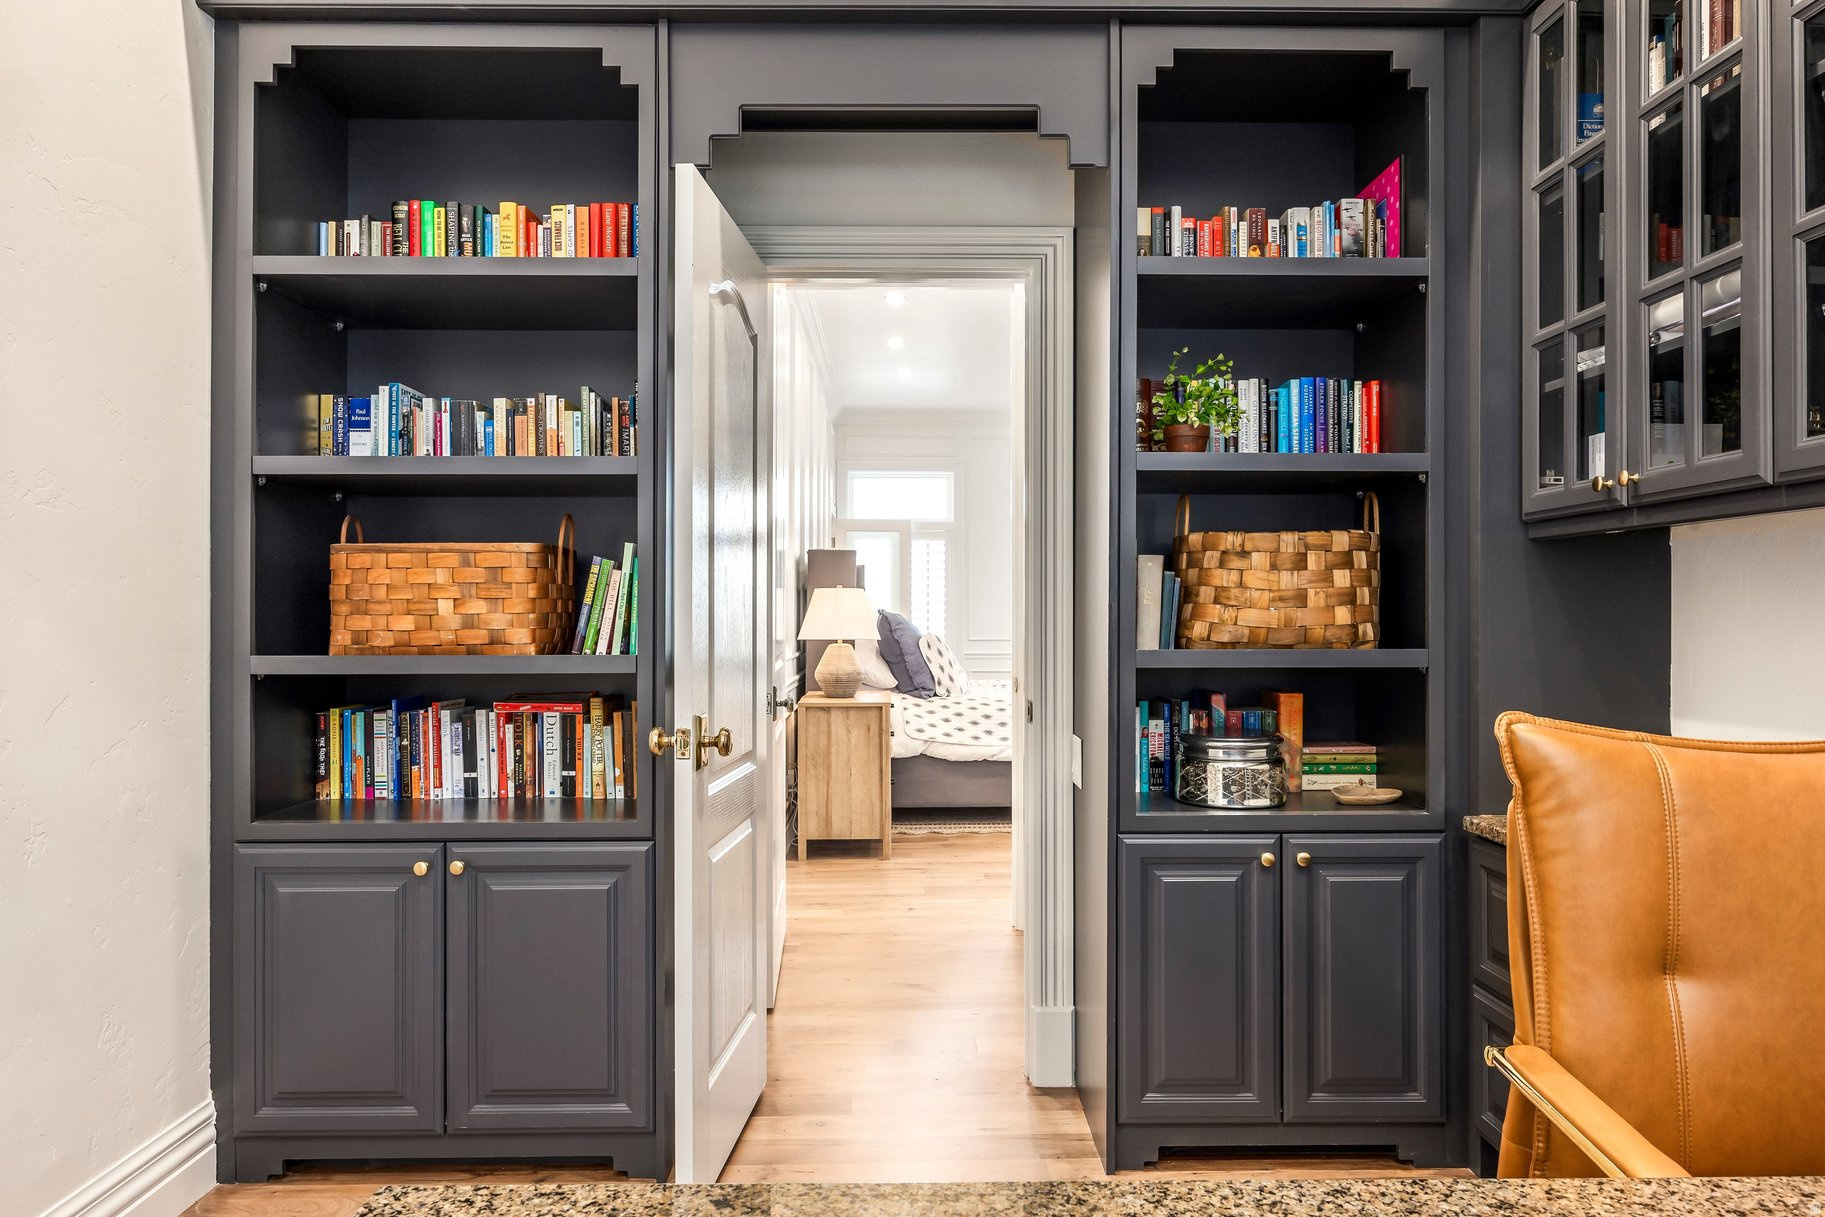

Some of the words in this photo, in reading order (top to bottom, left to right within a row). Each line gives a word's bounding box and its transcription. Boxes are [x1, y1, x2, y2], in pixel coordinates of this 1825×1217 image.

[603, 226, 612, 252] Moriarty
[1270, 226, 1278, 256] ANTIFRAGILE
[591, 564, 600, 574] THE
[584, 574, 598, 605] SACRAMENT
[591, 606, 600, 625] PARIS
[546, 715, 558, 756] Dutch
[595, 714, 603, 736] HARRY
[1173, 726, 1178, 735] DO
[595, 739, 603, 765] POTTER
